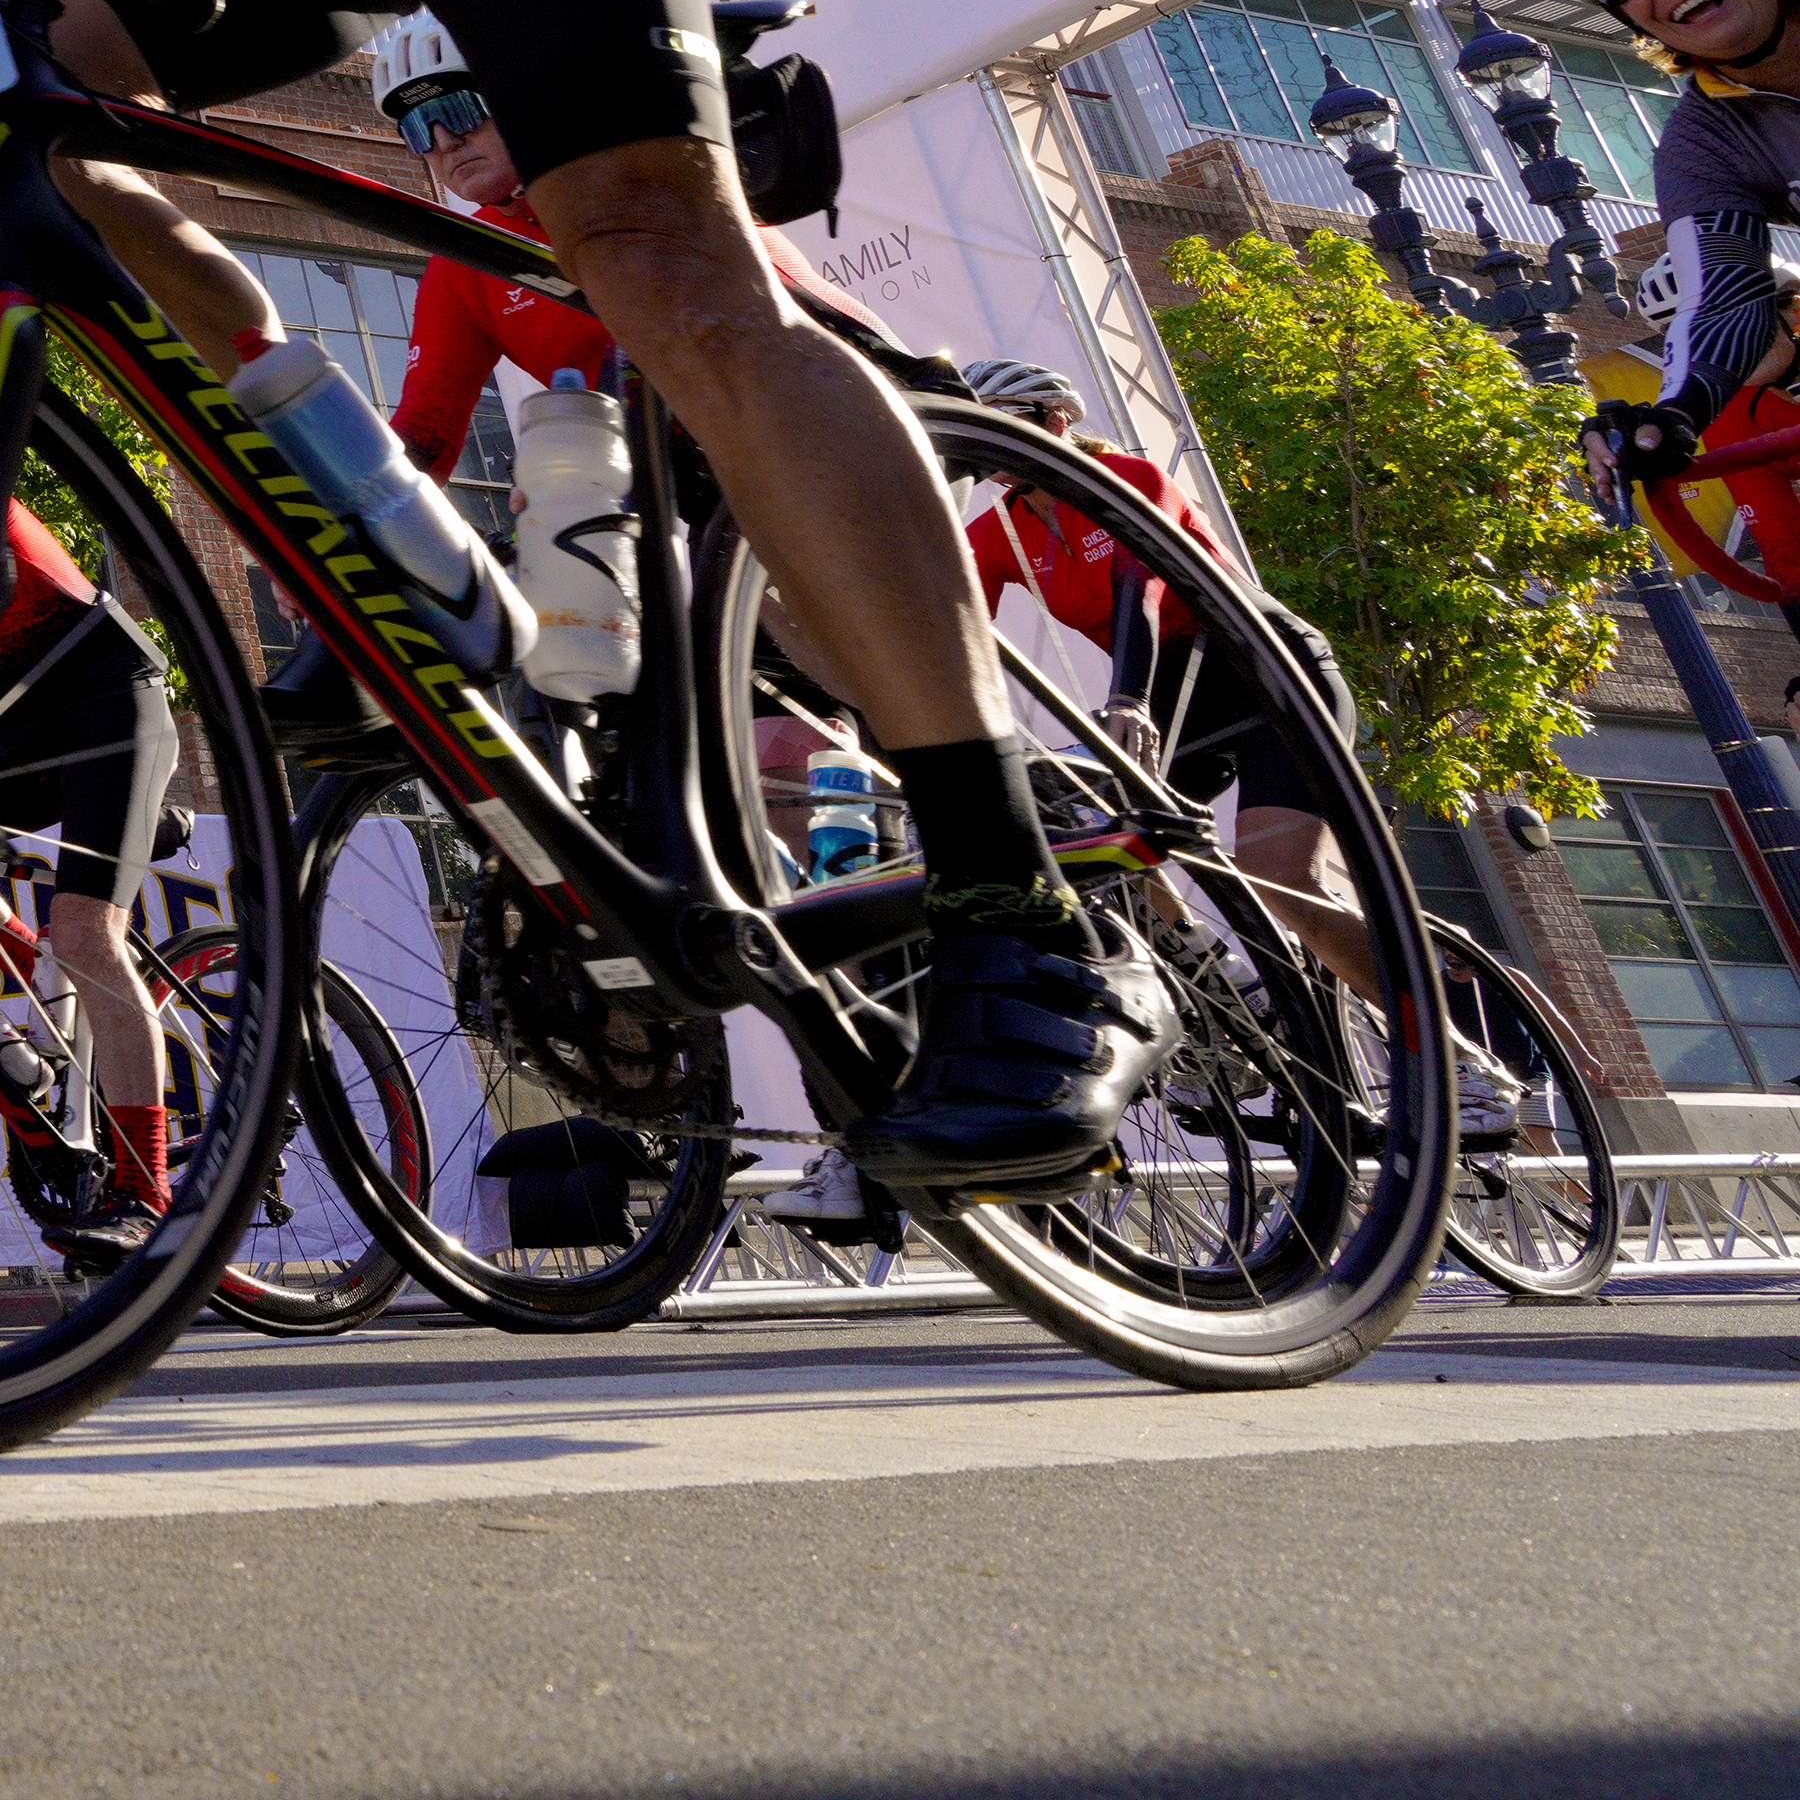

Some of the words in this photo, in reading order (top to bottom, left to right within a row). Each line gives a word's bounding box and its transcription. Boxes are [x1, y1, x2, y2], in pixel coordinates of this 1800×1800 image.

[399, 82, 431, 99] CANCER
[822, 225, 912, 288] AMILY
[503, 298, 535, 315] CUORE
